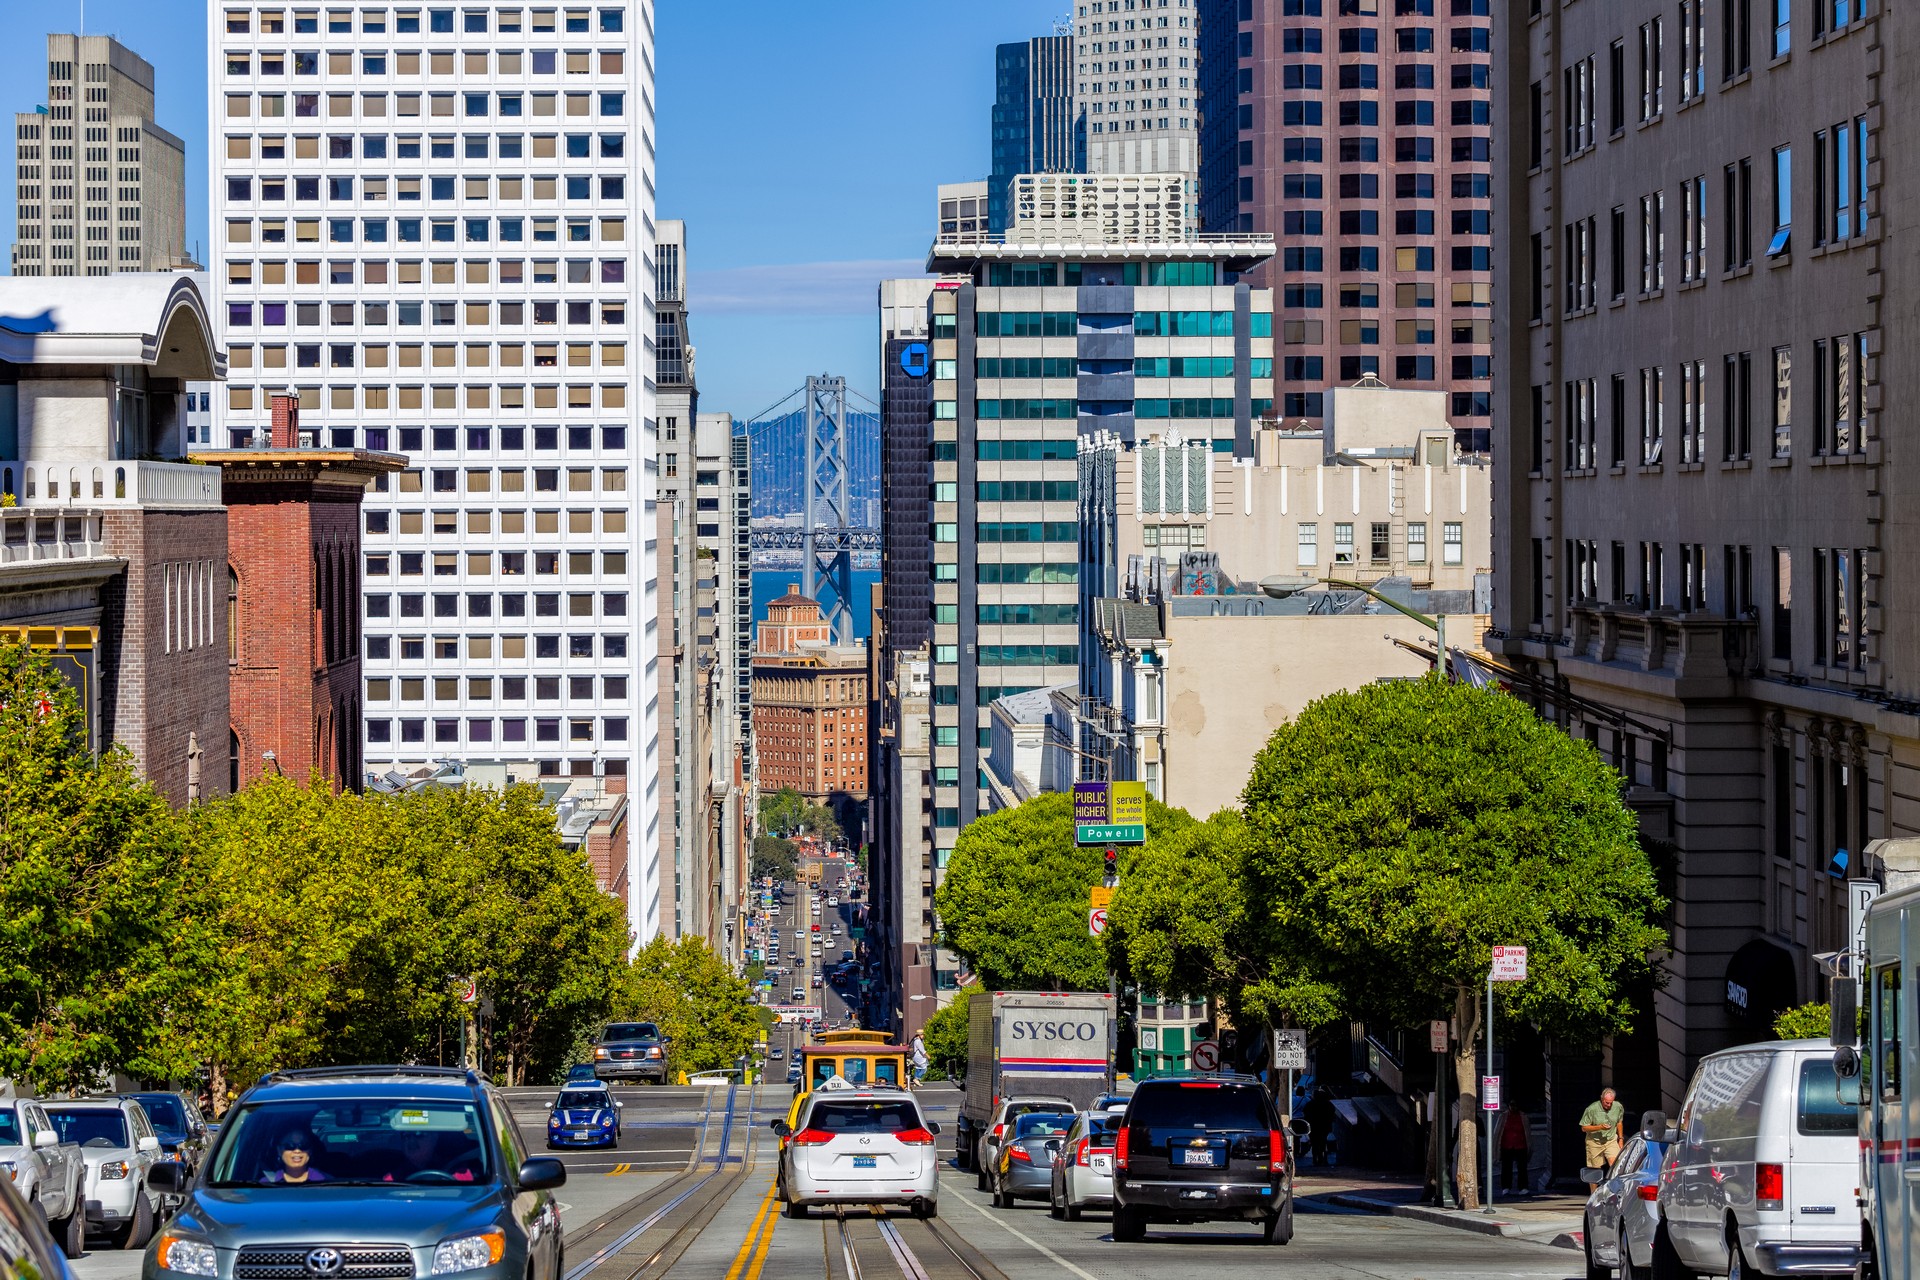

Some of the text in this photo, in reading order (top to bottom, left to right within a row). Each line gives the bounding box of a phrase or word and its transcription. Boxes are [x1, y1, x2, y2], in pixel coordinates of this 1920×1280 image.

[1075, 792, 1106, 803] PUBLIC
[1116, 797, 1142, 805] serves
[1075, 806, 1106, 817] HIGHER
[1126, 806, 1142, 814] whole
[1088, 829, 1134, 837] Powell
[1494, 947, 1503, 957] NO
[1012, 1020, 1096, 1041] SYSCO
[1093, 1158, 1105, 1167] 115
